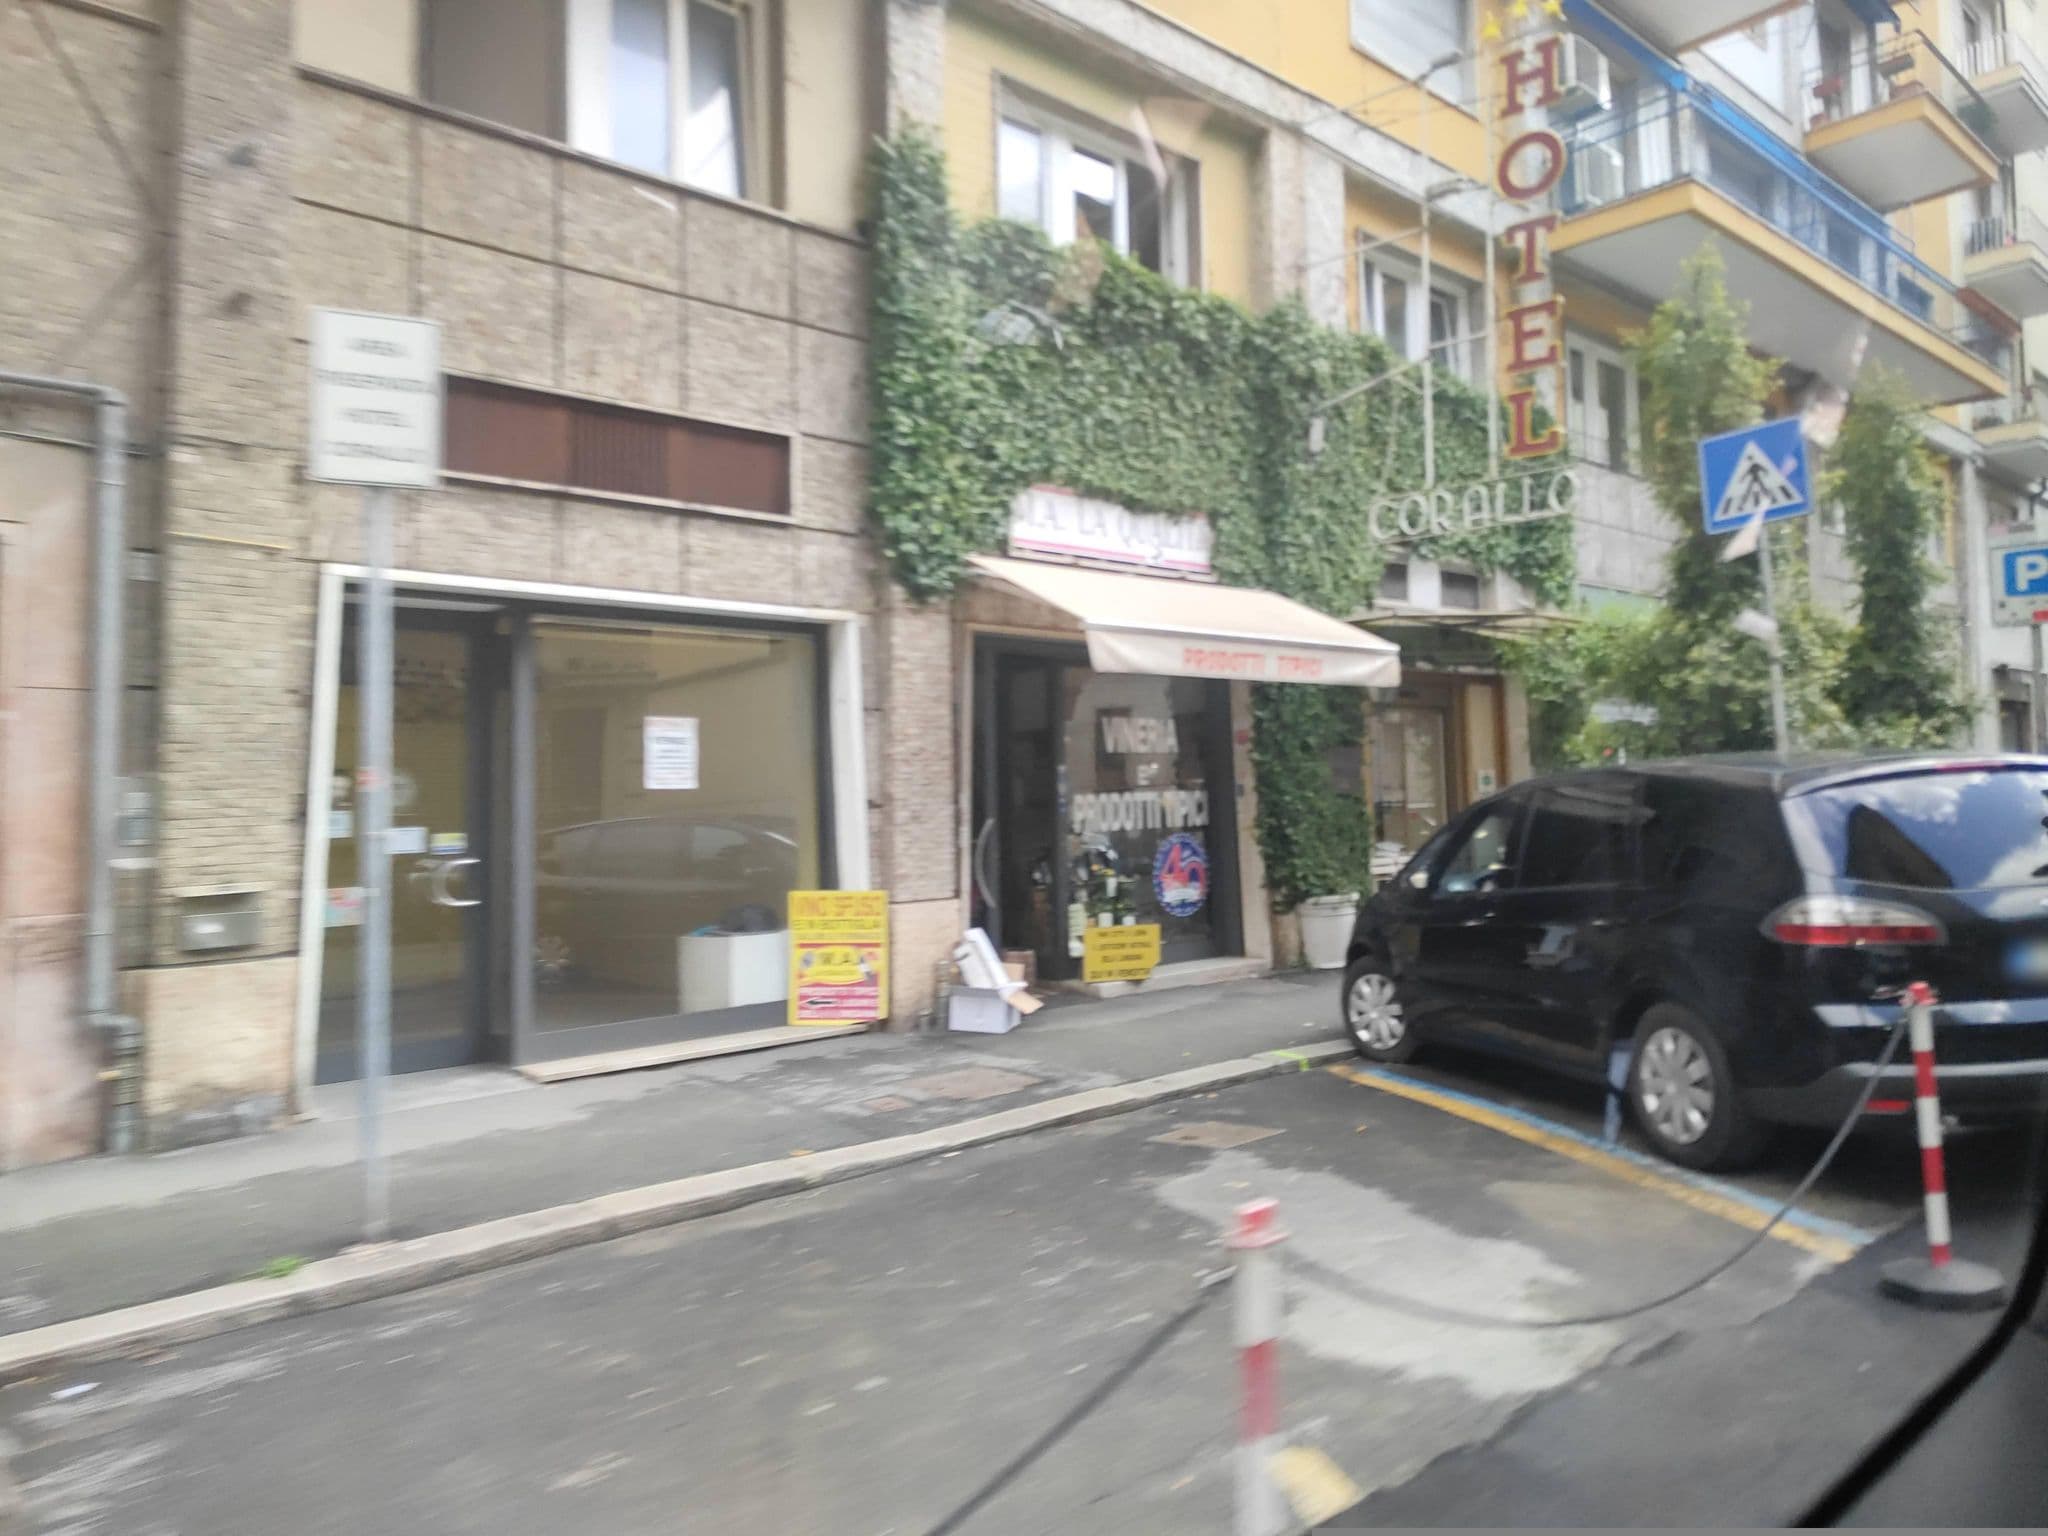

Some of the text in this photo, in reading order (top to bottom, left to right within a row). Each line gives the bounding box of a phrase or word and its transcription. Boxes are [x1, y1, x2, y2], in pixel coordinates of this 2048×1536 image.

[1498, 36, 1566, 460] HOTEL
[1369, 470, 1582, 541] CORALLO
[2015, 553, 2048, 593] P
